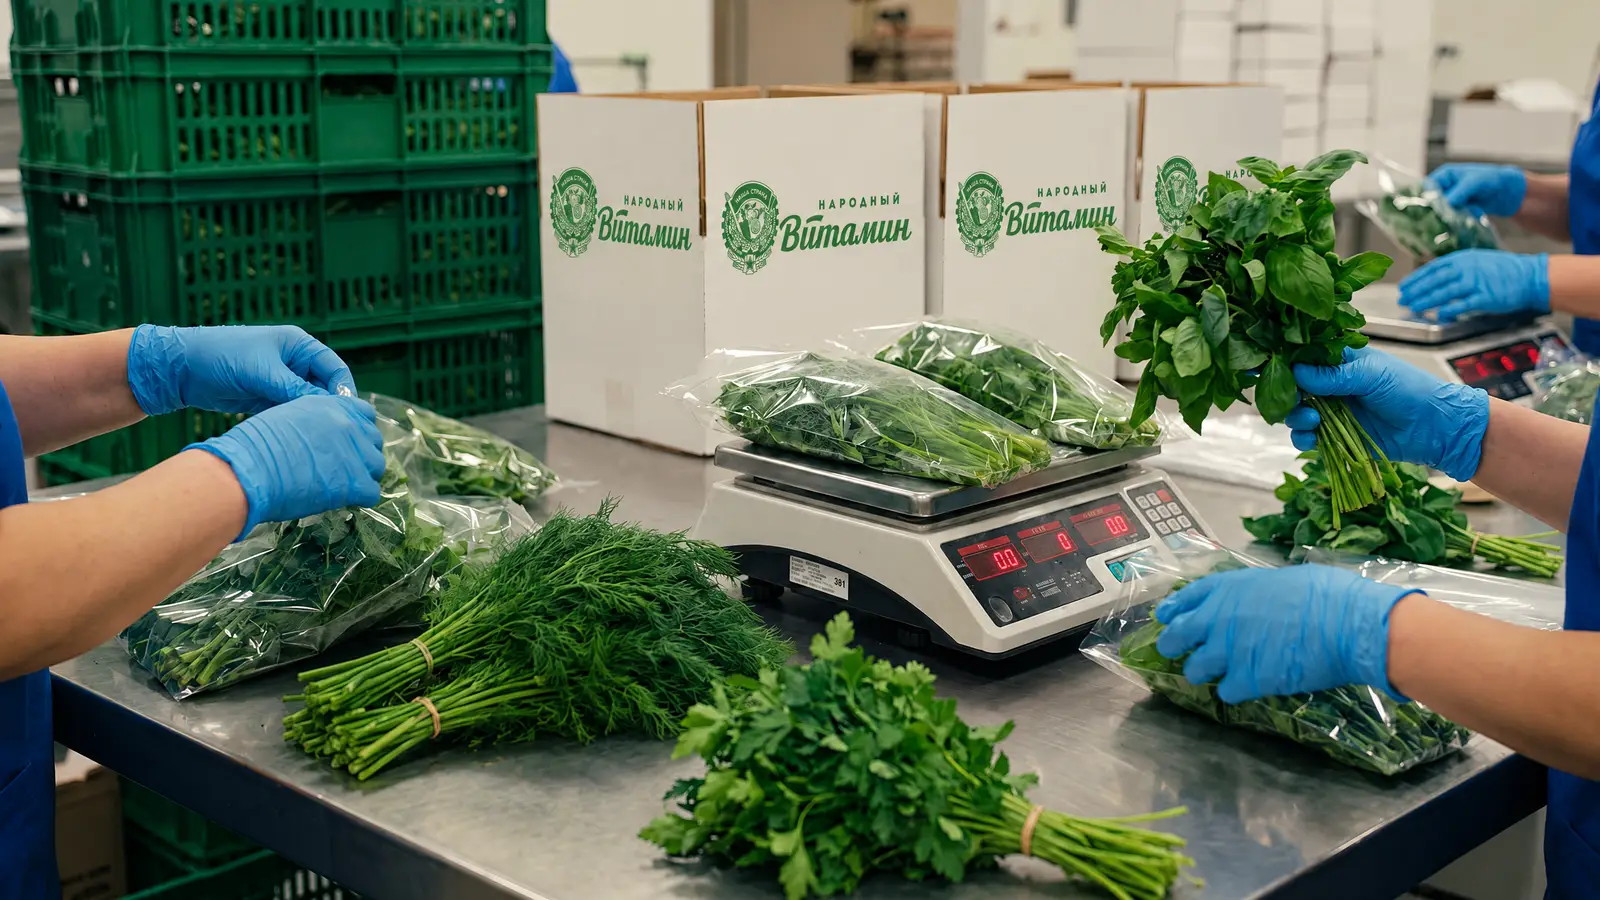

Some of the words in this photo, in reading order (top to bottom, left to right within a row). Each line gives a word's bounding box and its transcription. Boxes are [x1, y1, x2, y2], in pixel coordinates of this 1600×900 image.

[1225, 169, 1253, 179] НАРО
[735, 190, 750, 204] НАША
[750, 188, 768, 201] СТРАНА
[1037, 181, 1107, 198] НАРОДНЫЙ
[624, 195, 684, 212] НАРОДНЫЙ
[818, 192, 900, 210] НАРОДНЫЙ
[1004, 201, 1117, 237] Витамин
[597, 206, 693, 251] Витамин
[779, 214, 912, 253] Витамин
[1104, 515, 1129, 535] 0.0
[1057, 532, 1072, 550] 0
[993, 548, 1019, 570] 0.0
